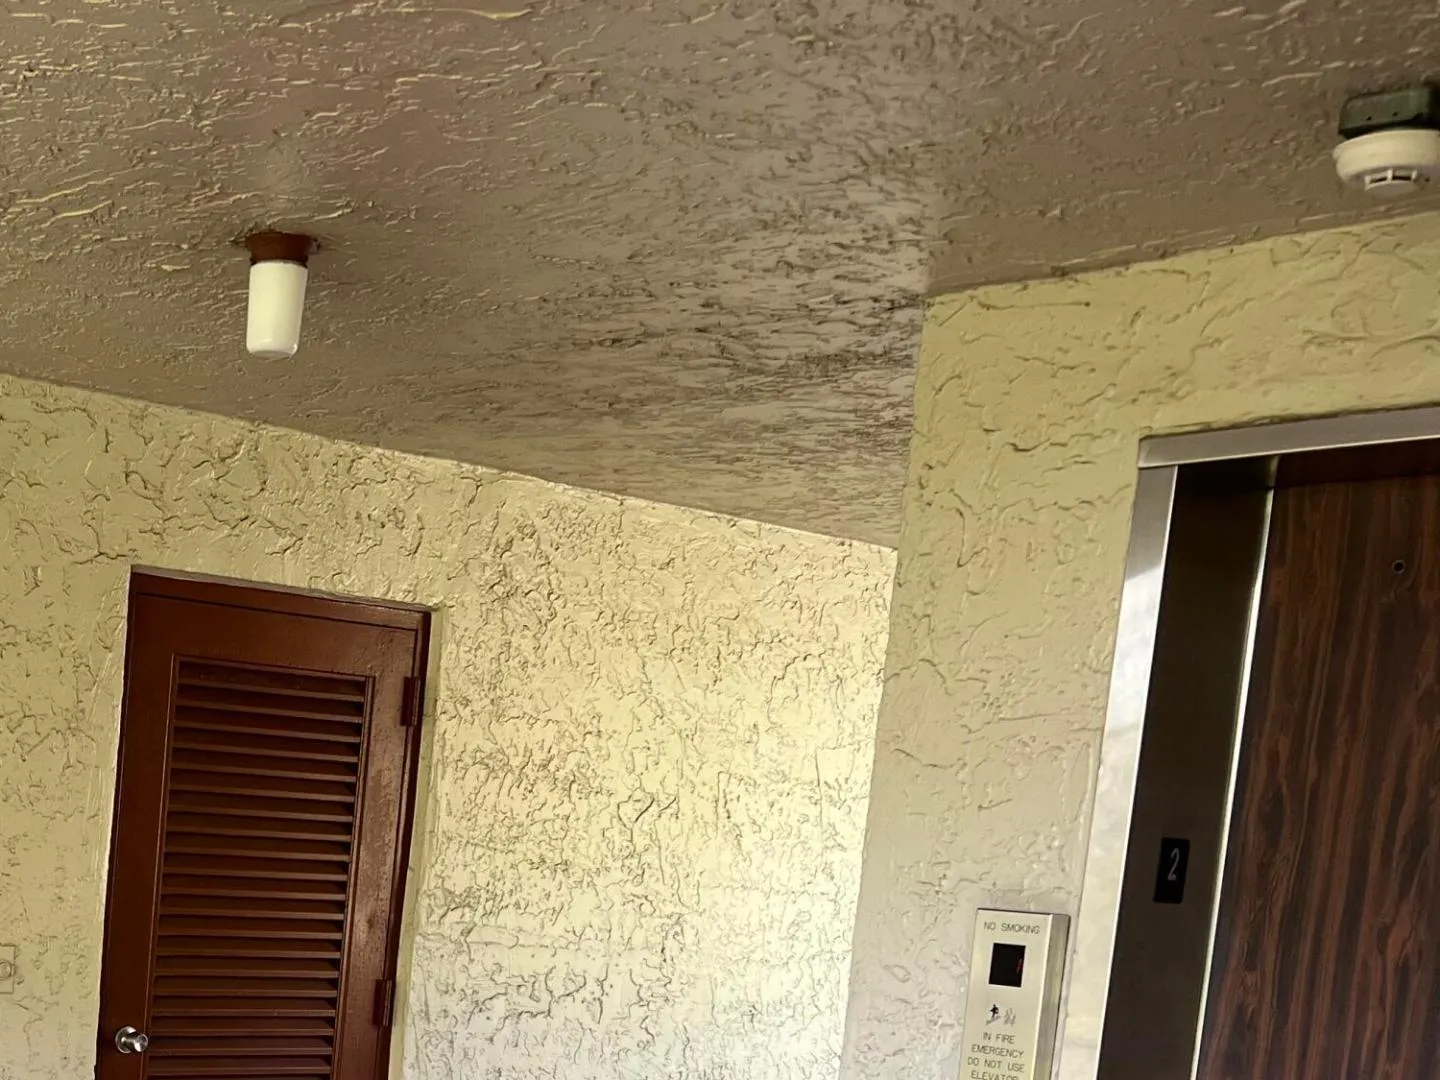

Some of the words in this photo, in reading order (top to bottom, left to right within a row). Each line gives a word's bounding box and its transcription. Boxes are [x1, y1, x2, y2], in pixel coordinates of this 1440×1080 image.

[1167, 847, 1180, 881] 2
[983, 921, 996, 931] NO
[1001, 923, 1040, 934] SMOKING
[983, 1031, 992, 1041] IN
[995, 1033, 1015, 1044] FIRE
[971, 1044, 1024, 1058] EMERGENCY
[967, 1056, 979, 1067] DO
[983, 1059, 1002, 1069] NOT
[1007, 1061, 1025, 1073] USE
